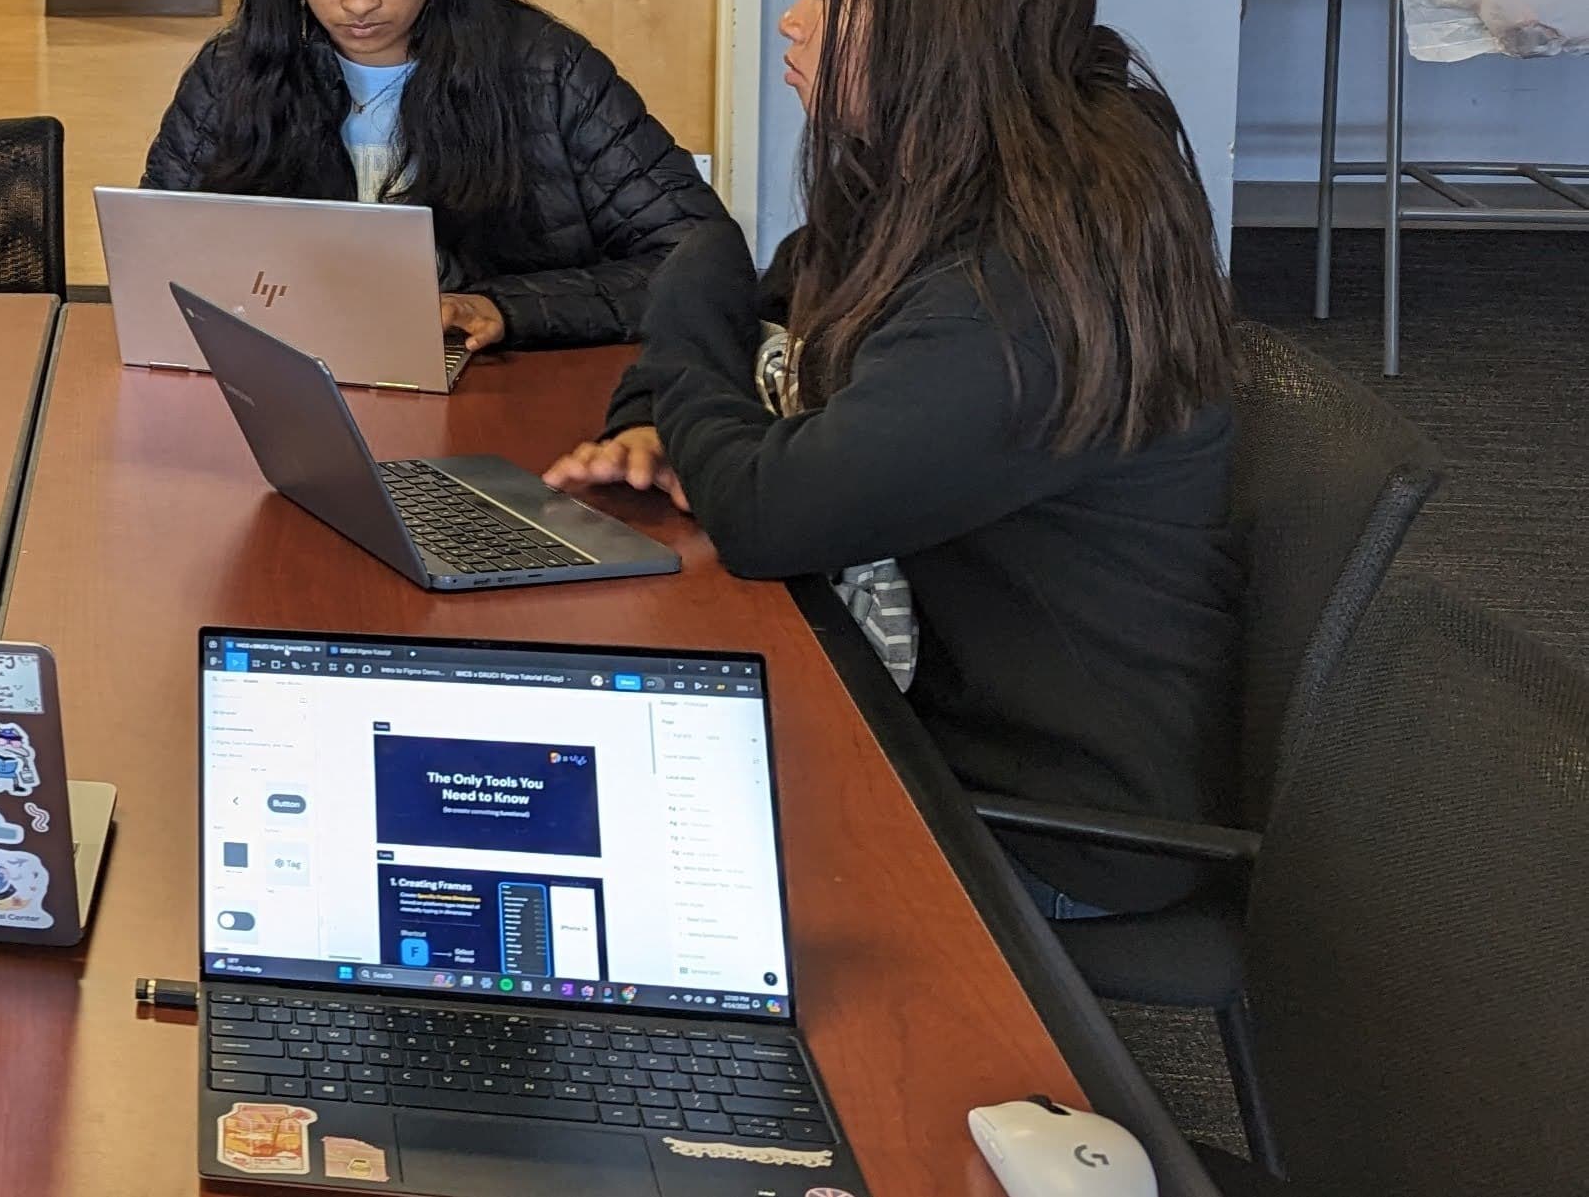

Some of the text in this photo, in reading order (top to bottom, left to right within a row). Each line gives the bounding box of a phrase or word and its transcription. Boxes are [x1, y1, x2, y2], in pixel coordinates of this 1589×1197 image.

[251, 270, 288, 308] hp
[426, 771, 544, 790] The Only Tools You
[272, 799, 301, 808] Button
[441, 789, 530, 805] Need to Know
[286, 859, 302, 871] Tag
[398, 877, 438, 892] Creating
[438, 880, 473, 892] Frames
[7, 913, 41, 922] Center
[411, 946, 420, 958] F
